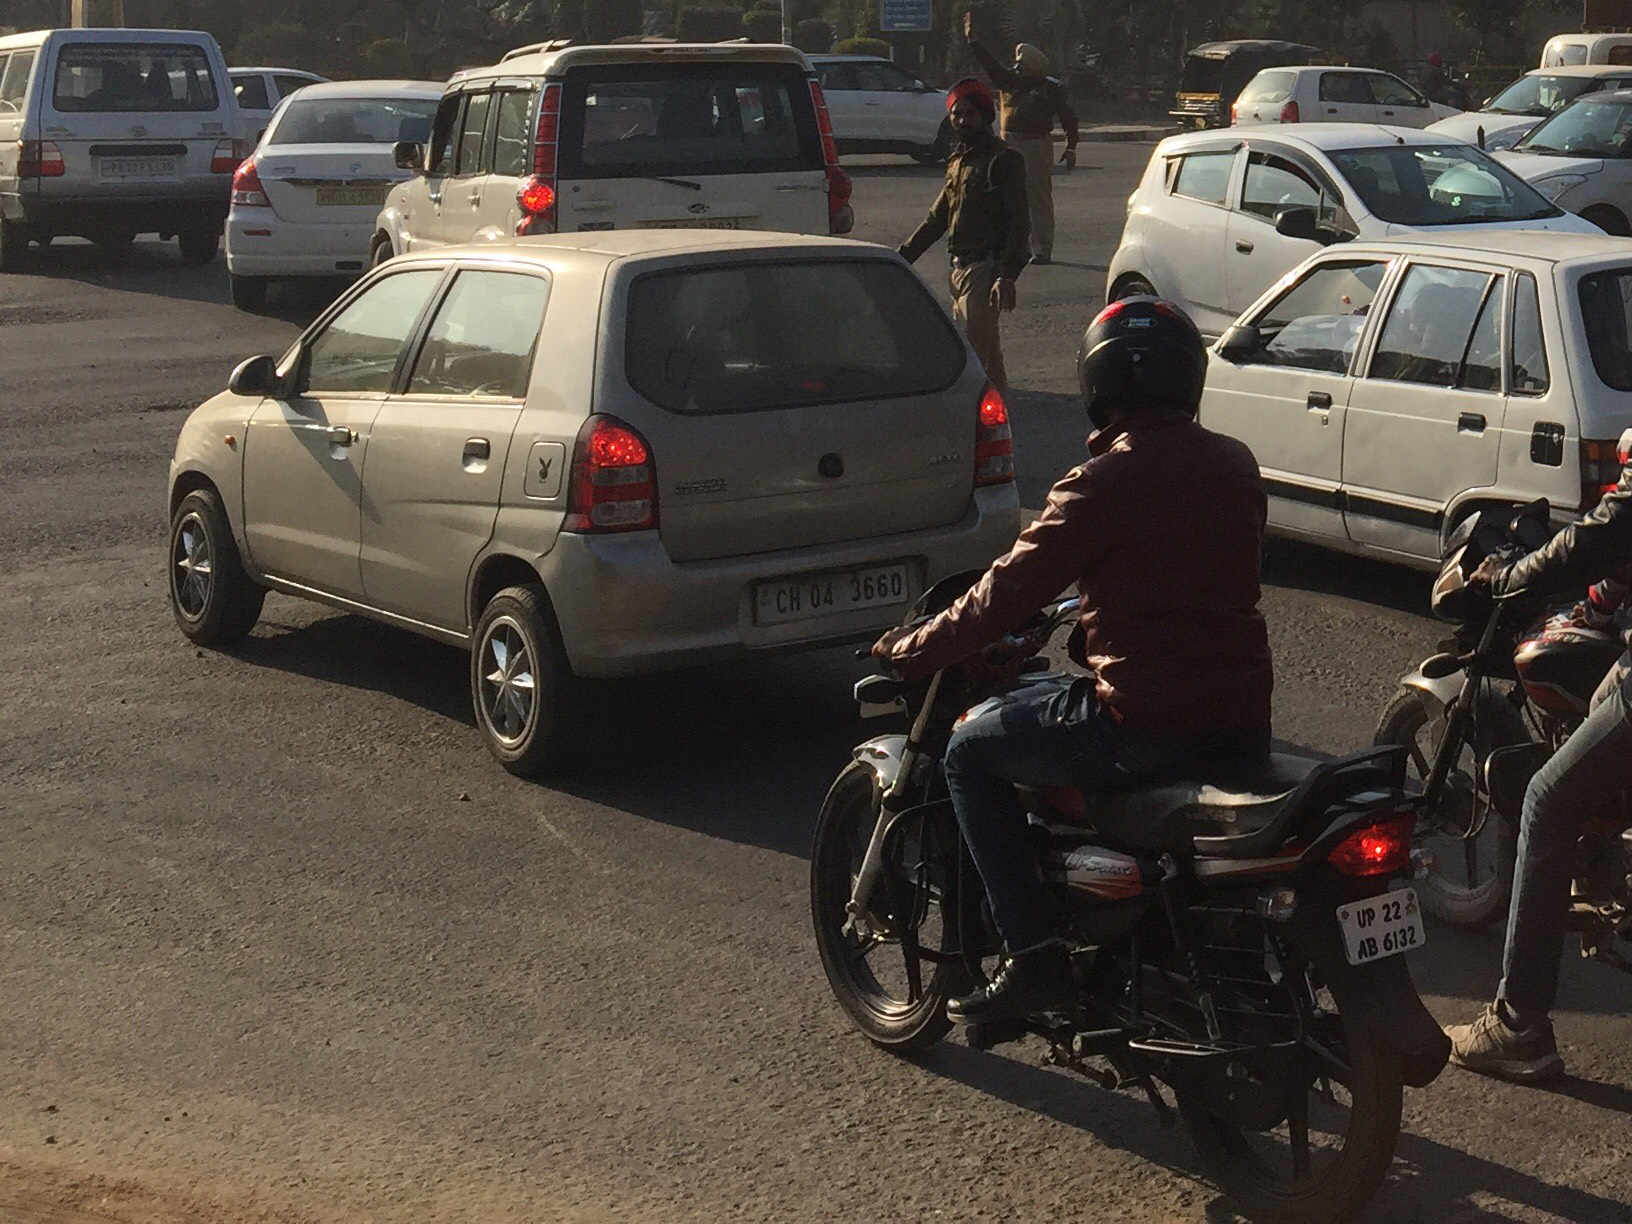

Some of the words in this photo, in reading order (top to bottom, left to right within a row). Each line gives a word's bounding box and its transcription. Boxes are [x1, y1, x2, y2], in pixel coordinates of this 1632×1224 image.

[776, 587, 800, 613] CH
[810, 583, 834, 608] 04
[851, 571, 902, 602] 3660
[1356, 906, 1376, 929] UP
[1382, 900, 1402, 923] 22
[1357, 936, 1379, 960] AB
[1383, 925, 1416, 952] 6132
